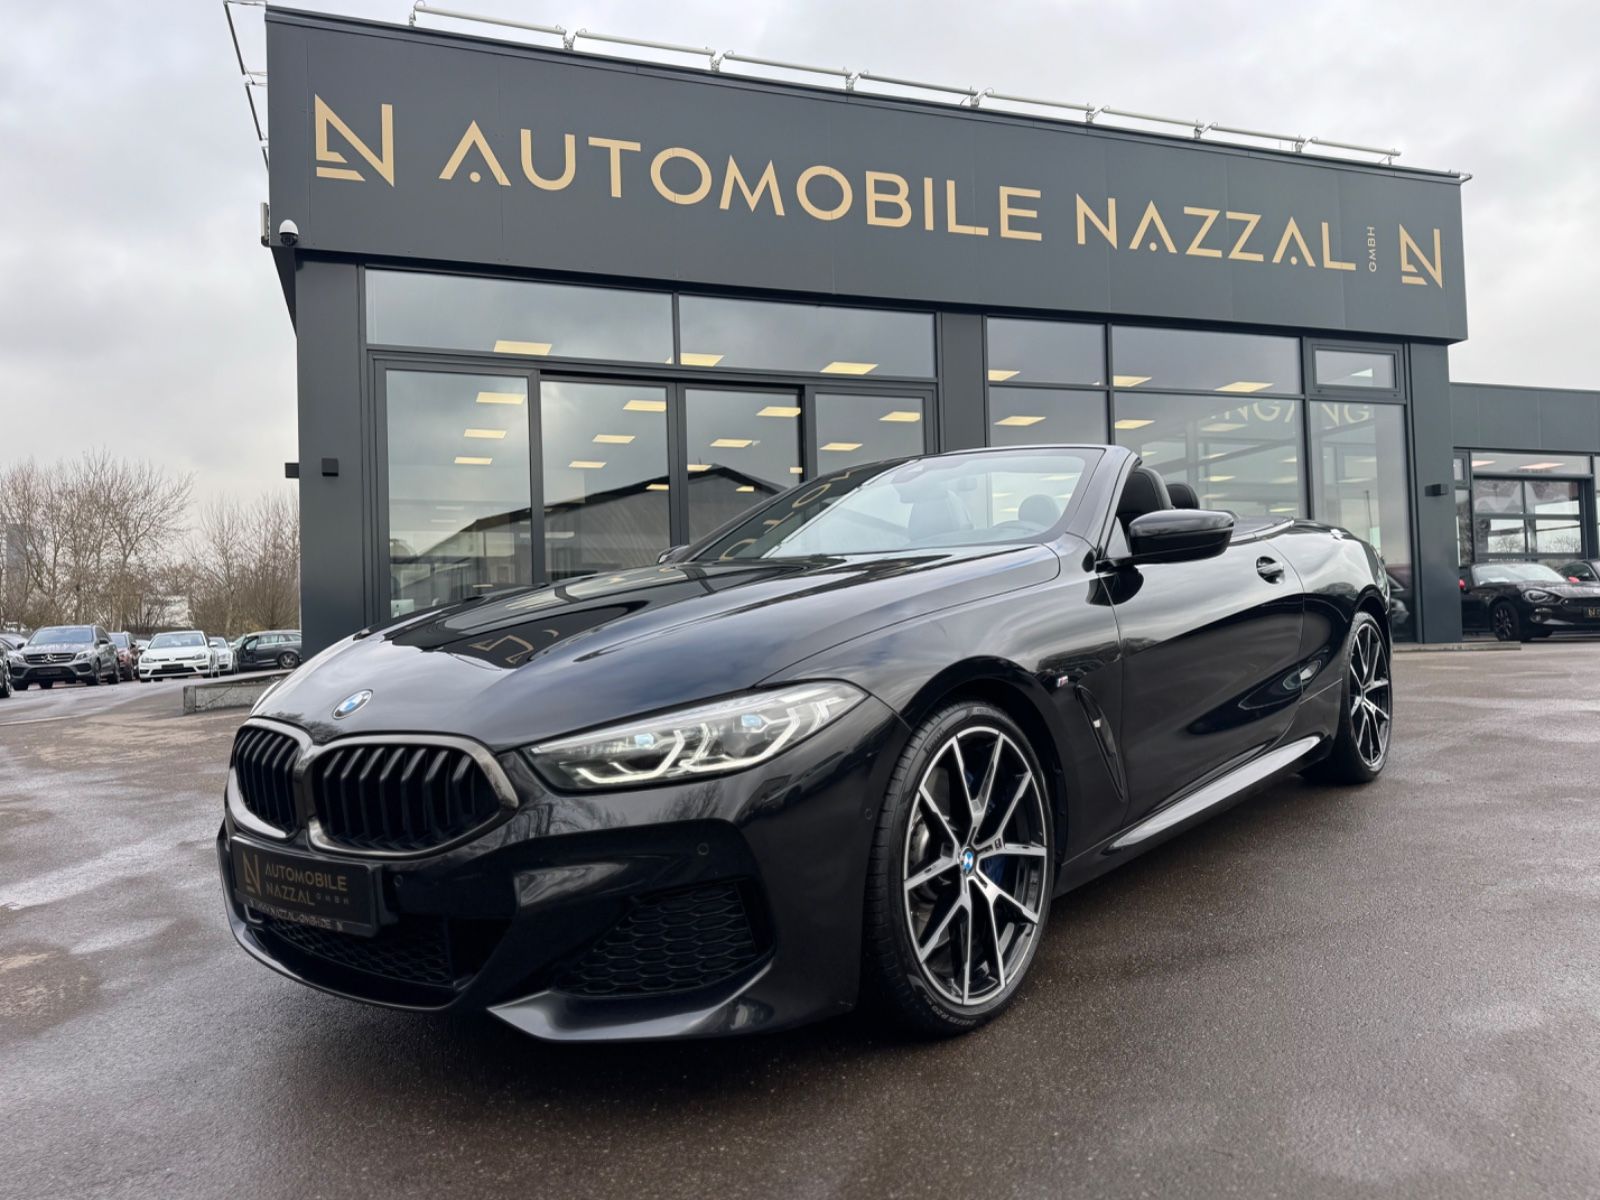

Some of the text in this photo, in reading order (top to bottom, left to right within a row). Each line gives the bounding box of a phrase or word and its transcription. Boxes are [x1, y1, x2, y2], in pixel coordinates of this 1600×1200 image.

[438, 119, 1043, 242] AUTOMOBILE
[1076, 193, 1357, 271] NAZZAL
[265, 863, 348, 891] AUTOMOBILE
[266, 882, 315, 906] NAZZAL
